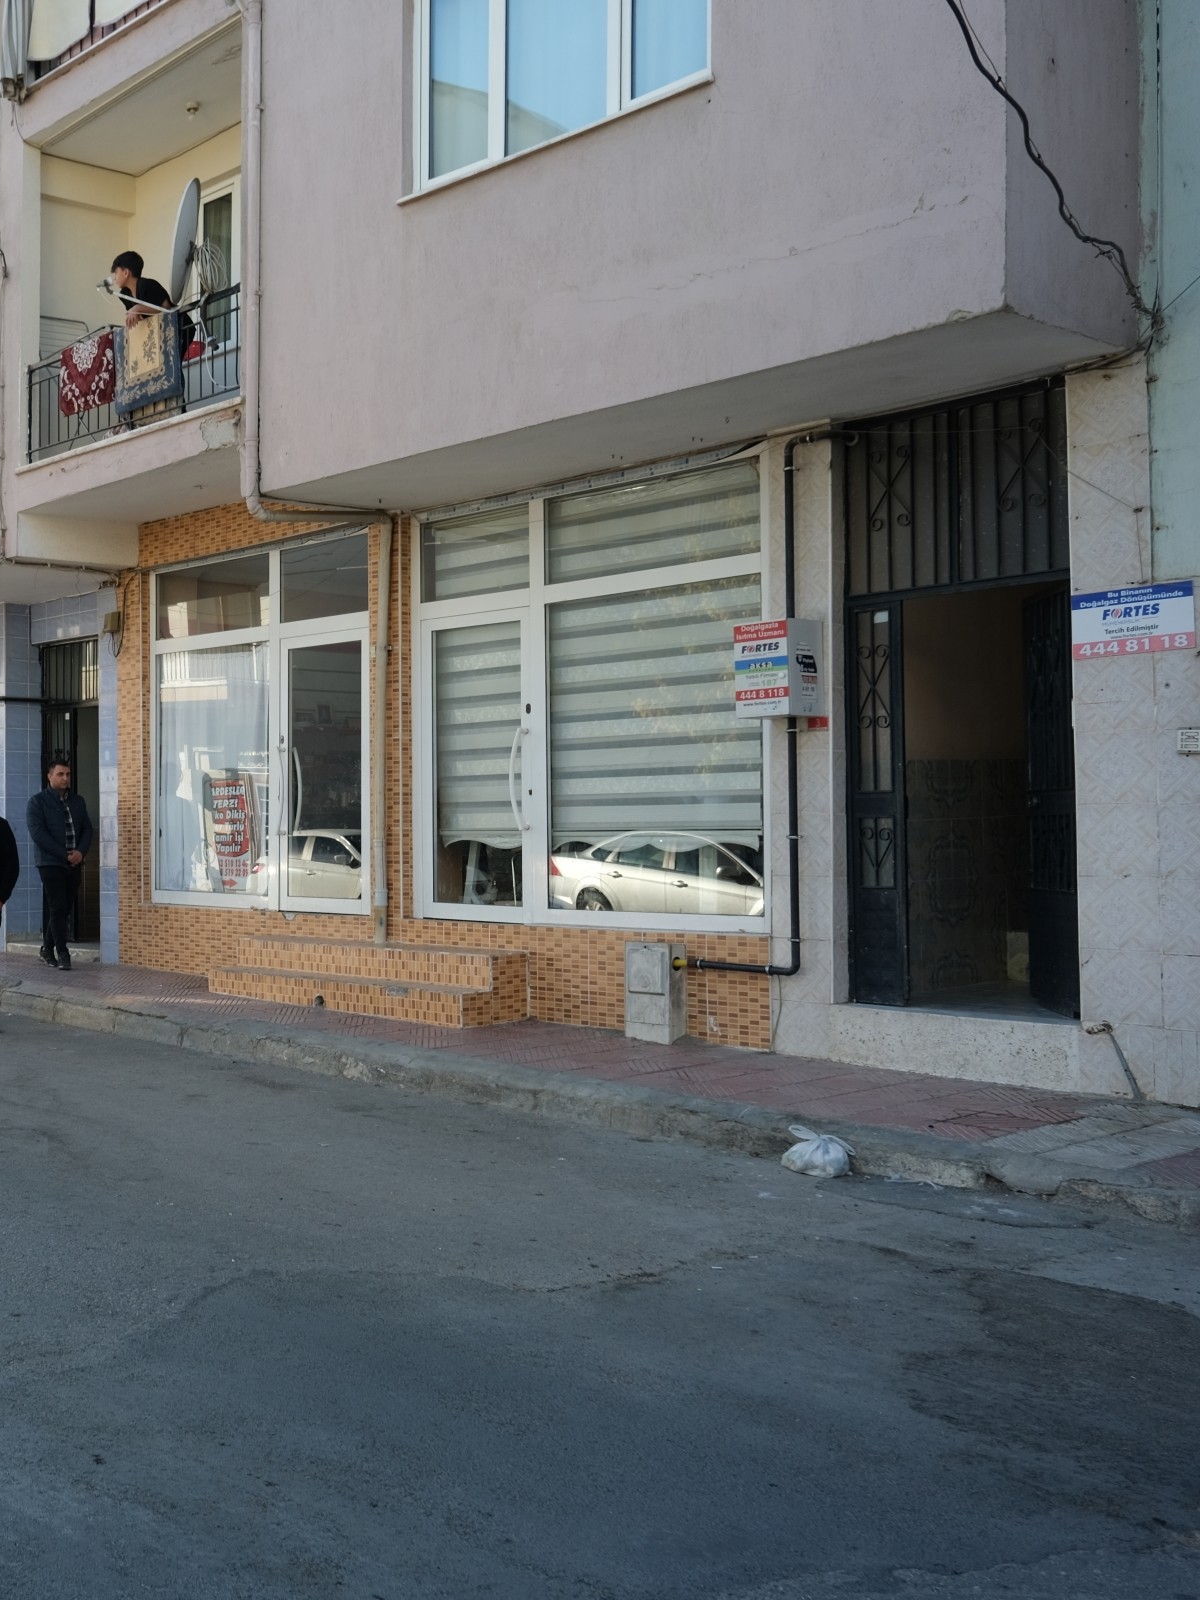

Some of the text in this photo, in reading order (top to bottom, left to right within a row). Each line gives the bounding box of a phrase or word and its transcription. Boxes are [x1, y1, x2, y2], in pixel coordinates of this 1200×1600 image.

[1120, 588, 1153, 597] Binanın
[1080, 590, 1184, 608] Doğalgaz Dönüşümünde
[1102, 603, 1160, 620] FORTES
[741, 622, 779, 632] Doğalgazla
[1126, 624, 1159, 633] Edilmiştir
[758, 630, 784, 638] Uzmanı
[741, 641, 780, 654] FORTES
[1080, 634, 1188, 656] 444 81 18
[749, 661, 773, 669] aksa
[740, 688, 784, 700] 444 8 118
[216, 843, 241, 854] Yapılır
